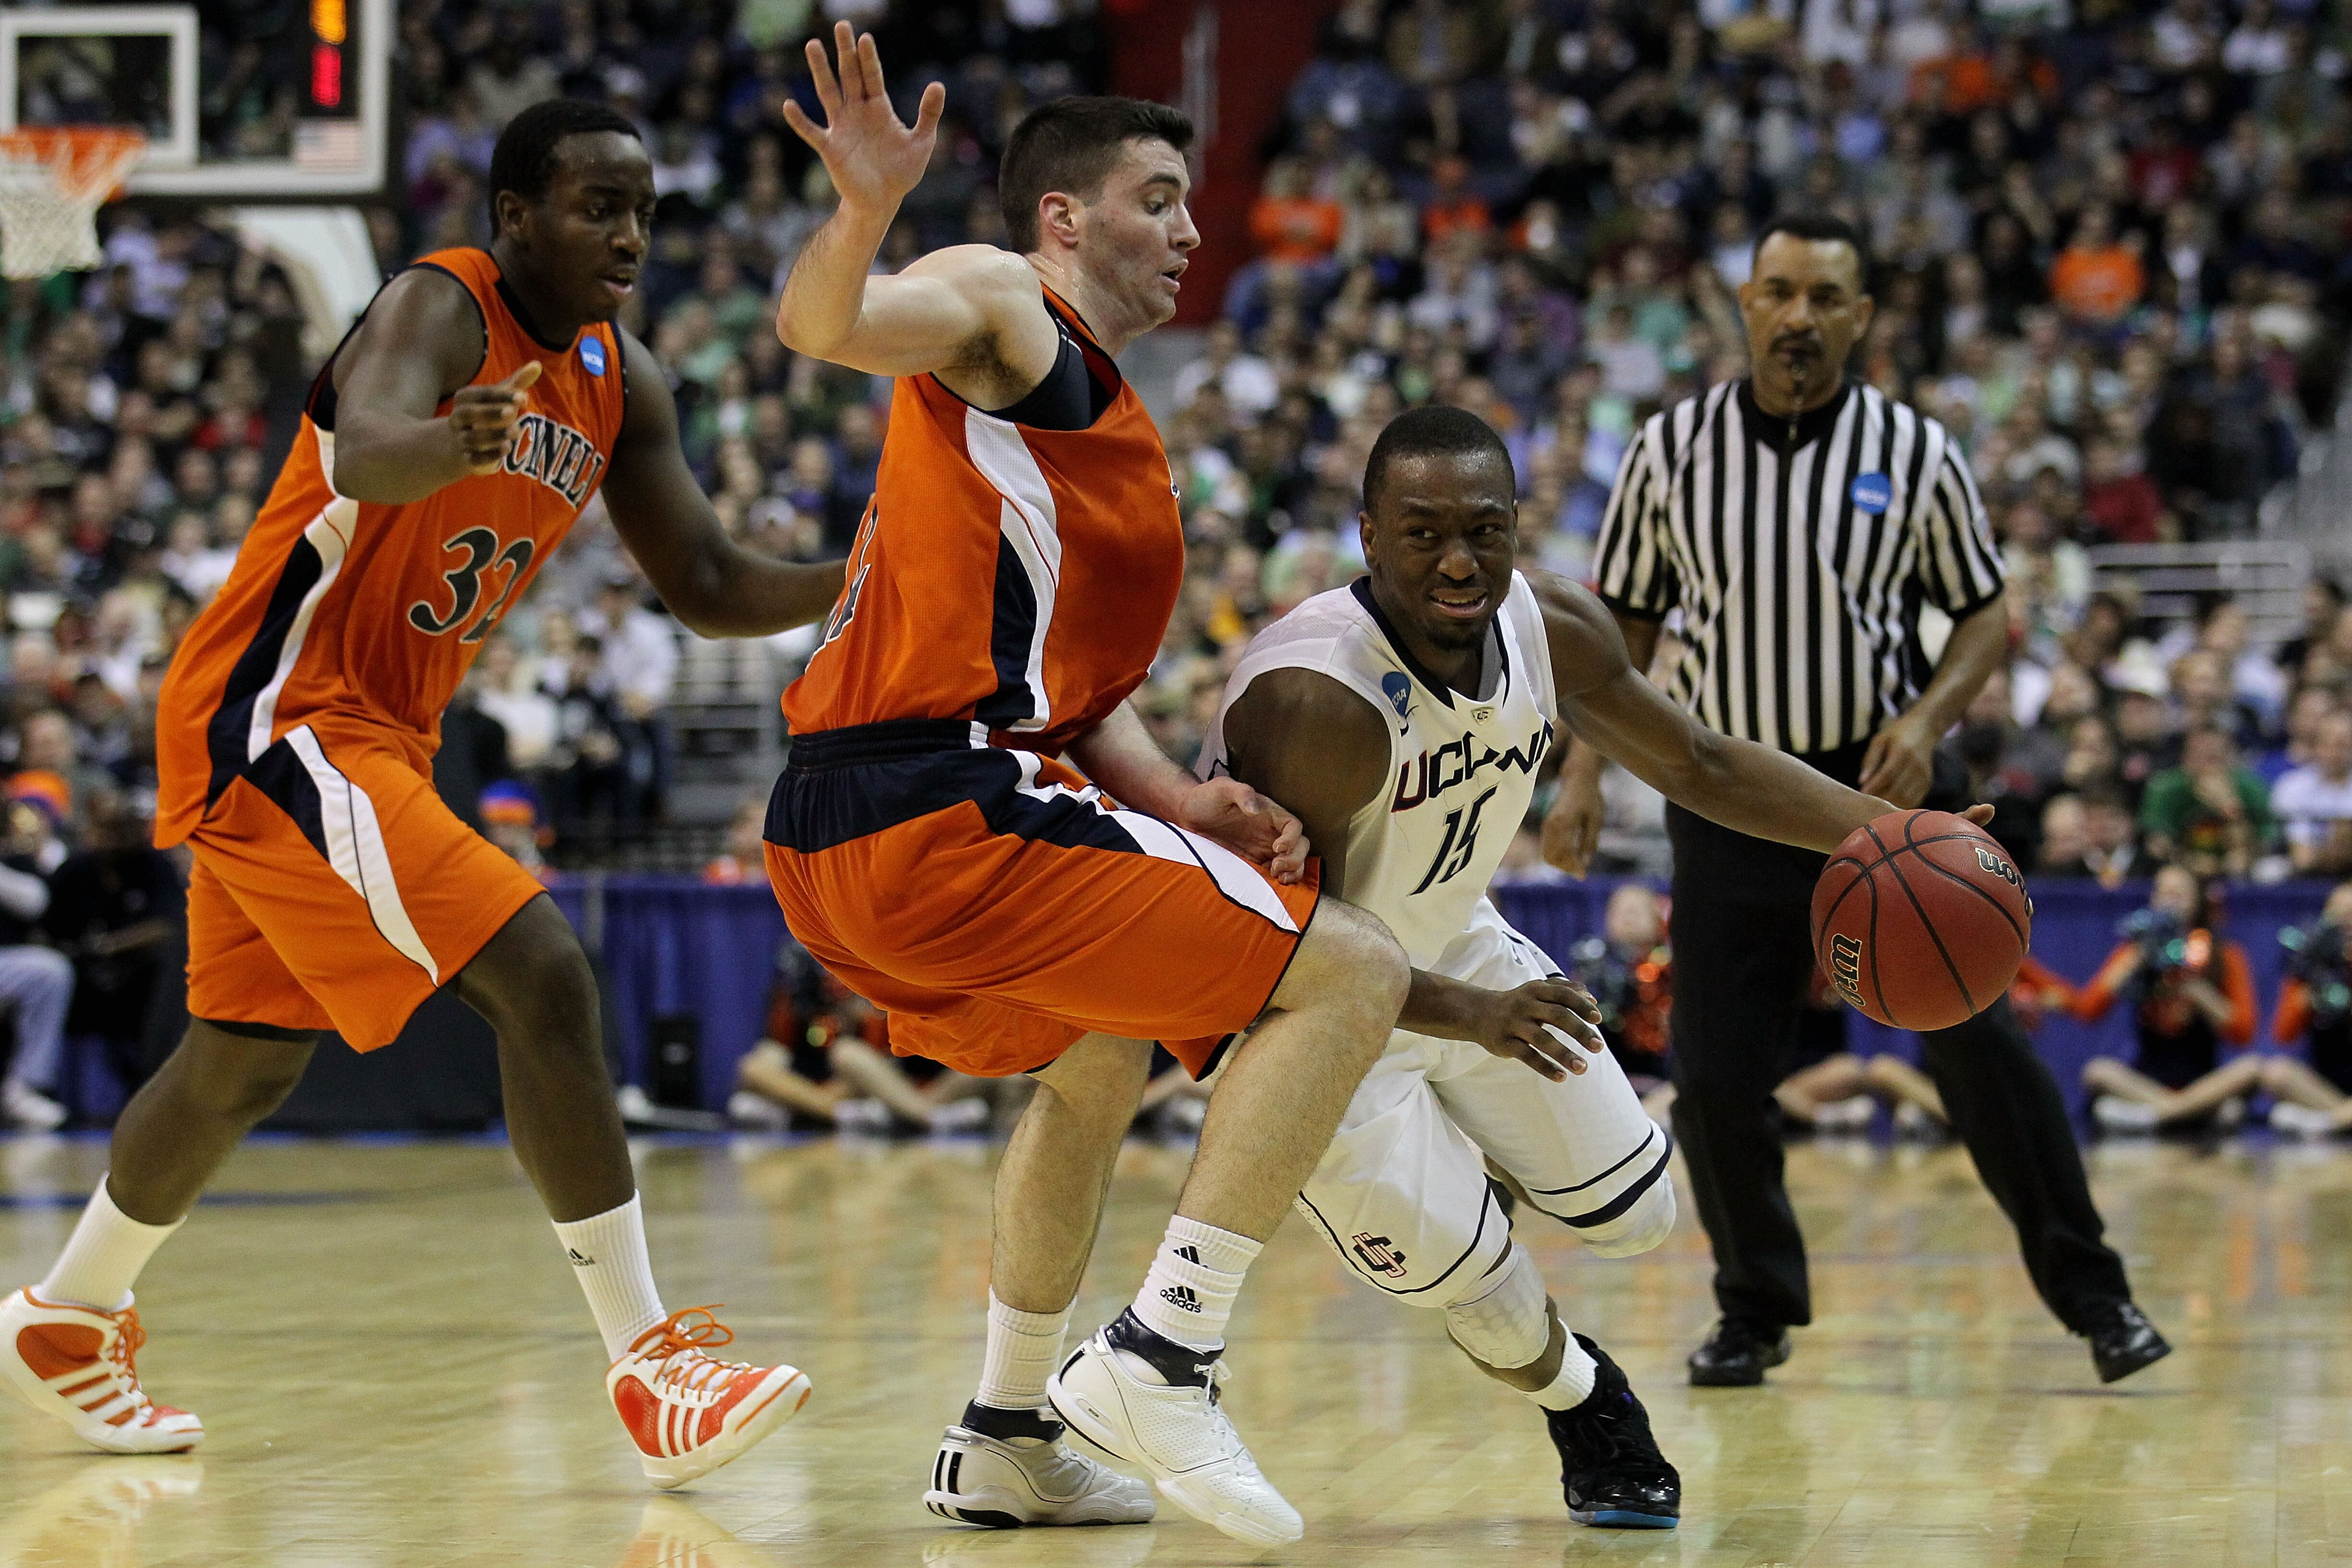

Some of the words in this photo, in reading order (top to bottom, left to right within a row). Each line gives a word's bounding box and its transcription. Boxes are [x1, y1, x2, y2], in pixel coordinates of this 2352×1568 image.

[408, 525, 535, 645] 32
[1408, 782, 1500, 896] 15
[1830, 933, 1866, 1009] Wil
[1160, 1289, 1202, 1313] adidas
